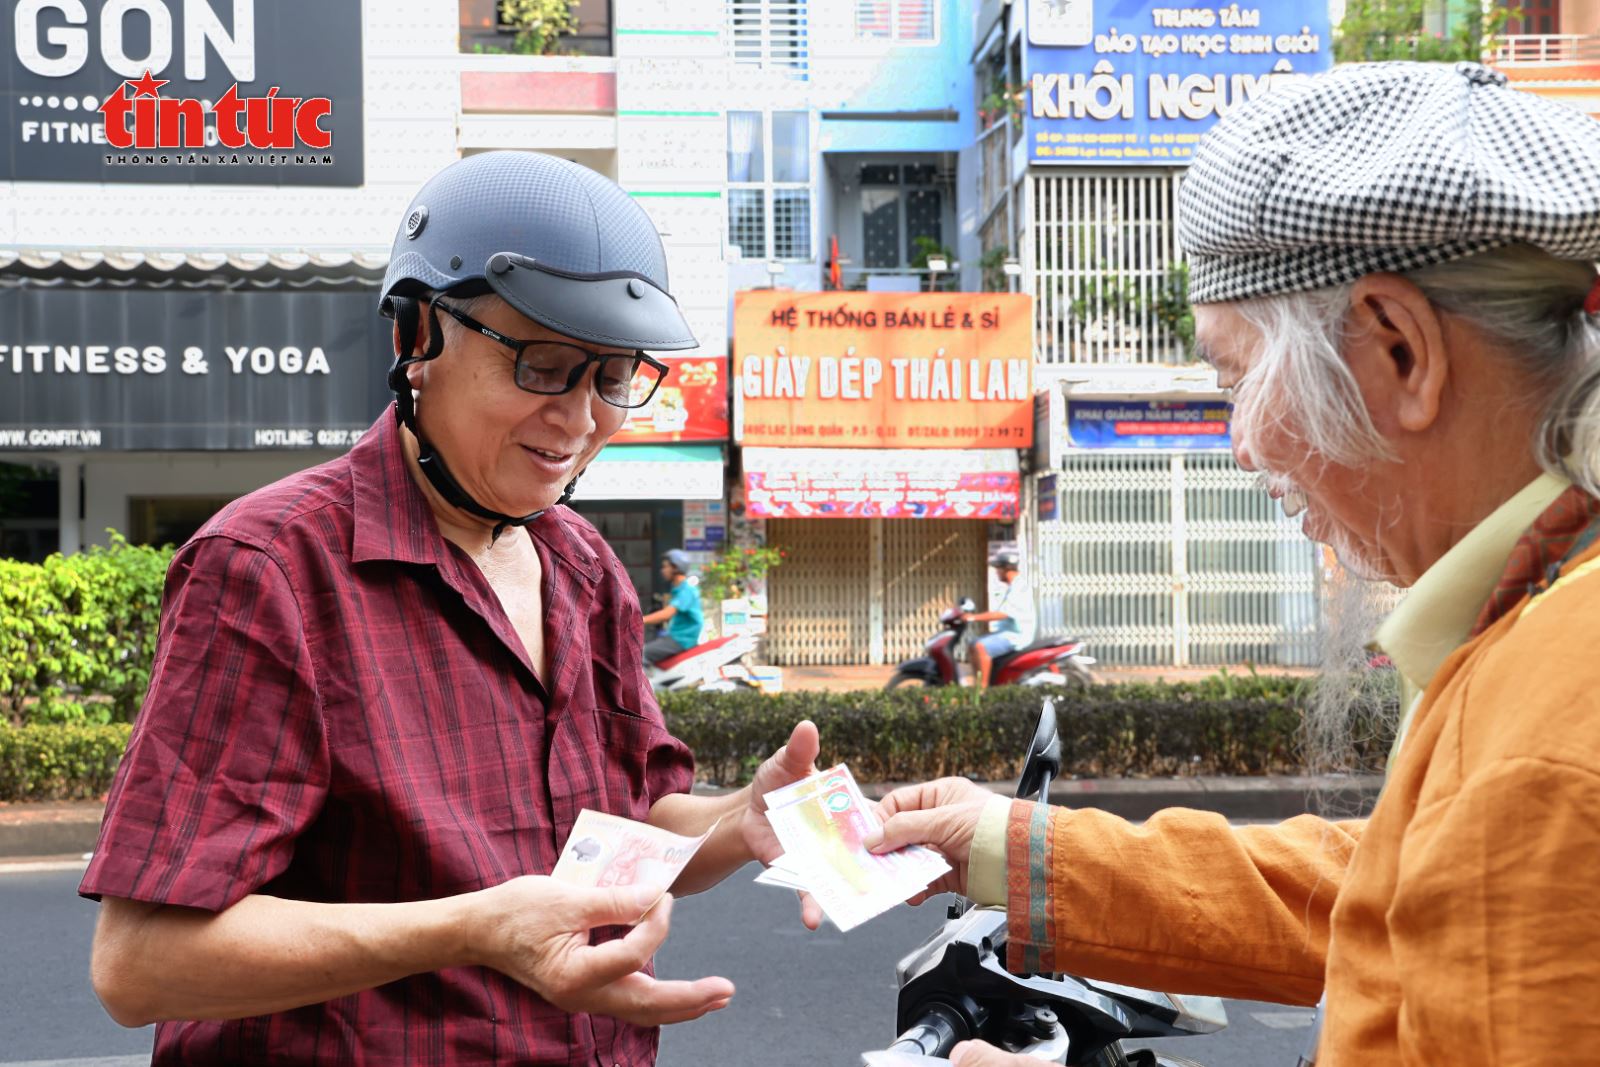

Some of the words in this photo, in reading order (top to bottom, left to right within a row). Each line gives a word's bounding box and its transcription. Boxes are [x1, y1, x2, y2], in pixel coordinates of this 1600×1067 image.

[1152, 8, 1216, 28] TRUNG
[1218, 3, 1260, 28] TÂM
[14, 0, 256, 82] GON
[1140, 34, 1180, 58] TẠO
[1181, 34, 1227, 58] HỌC
[1229, 34, 1272, 54] SINH
[1031, 59, 1135, 120] KHÔI
[771, 305, 798, 331] HỆ
[805, 303, 877, 329] THỐNG
[884, 307, 926, 329] BÁN
[960, 312, 973, 329] &
[181, 346, 209, 375] &
[224, 346, 331, 375] YOGA
[742, 345, 811, 398] GIÀY
[819, 345, 883, 400] DÉP
[890, 347, 962, 400] THÁI
[968, 357, 1029, 401] LAN
